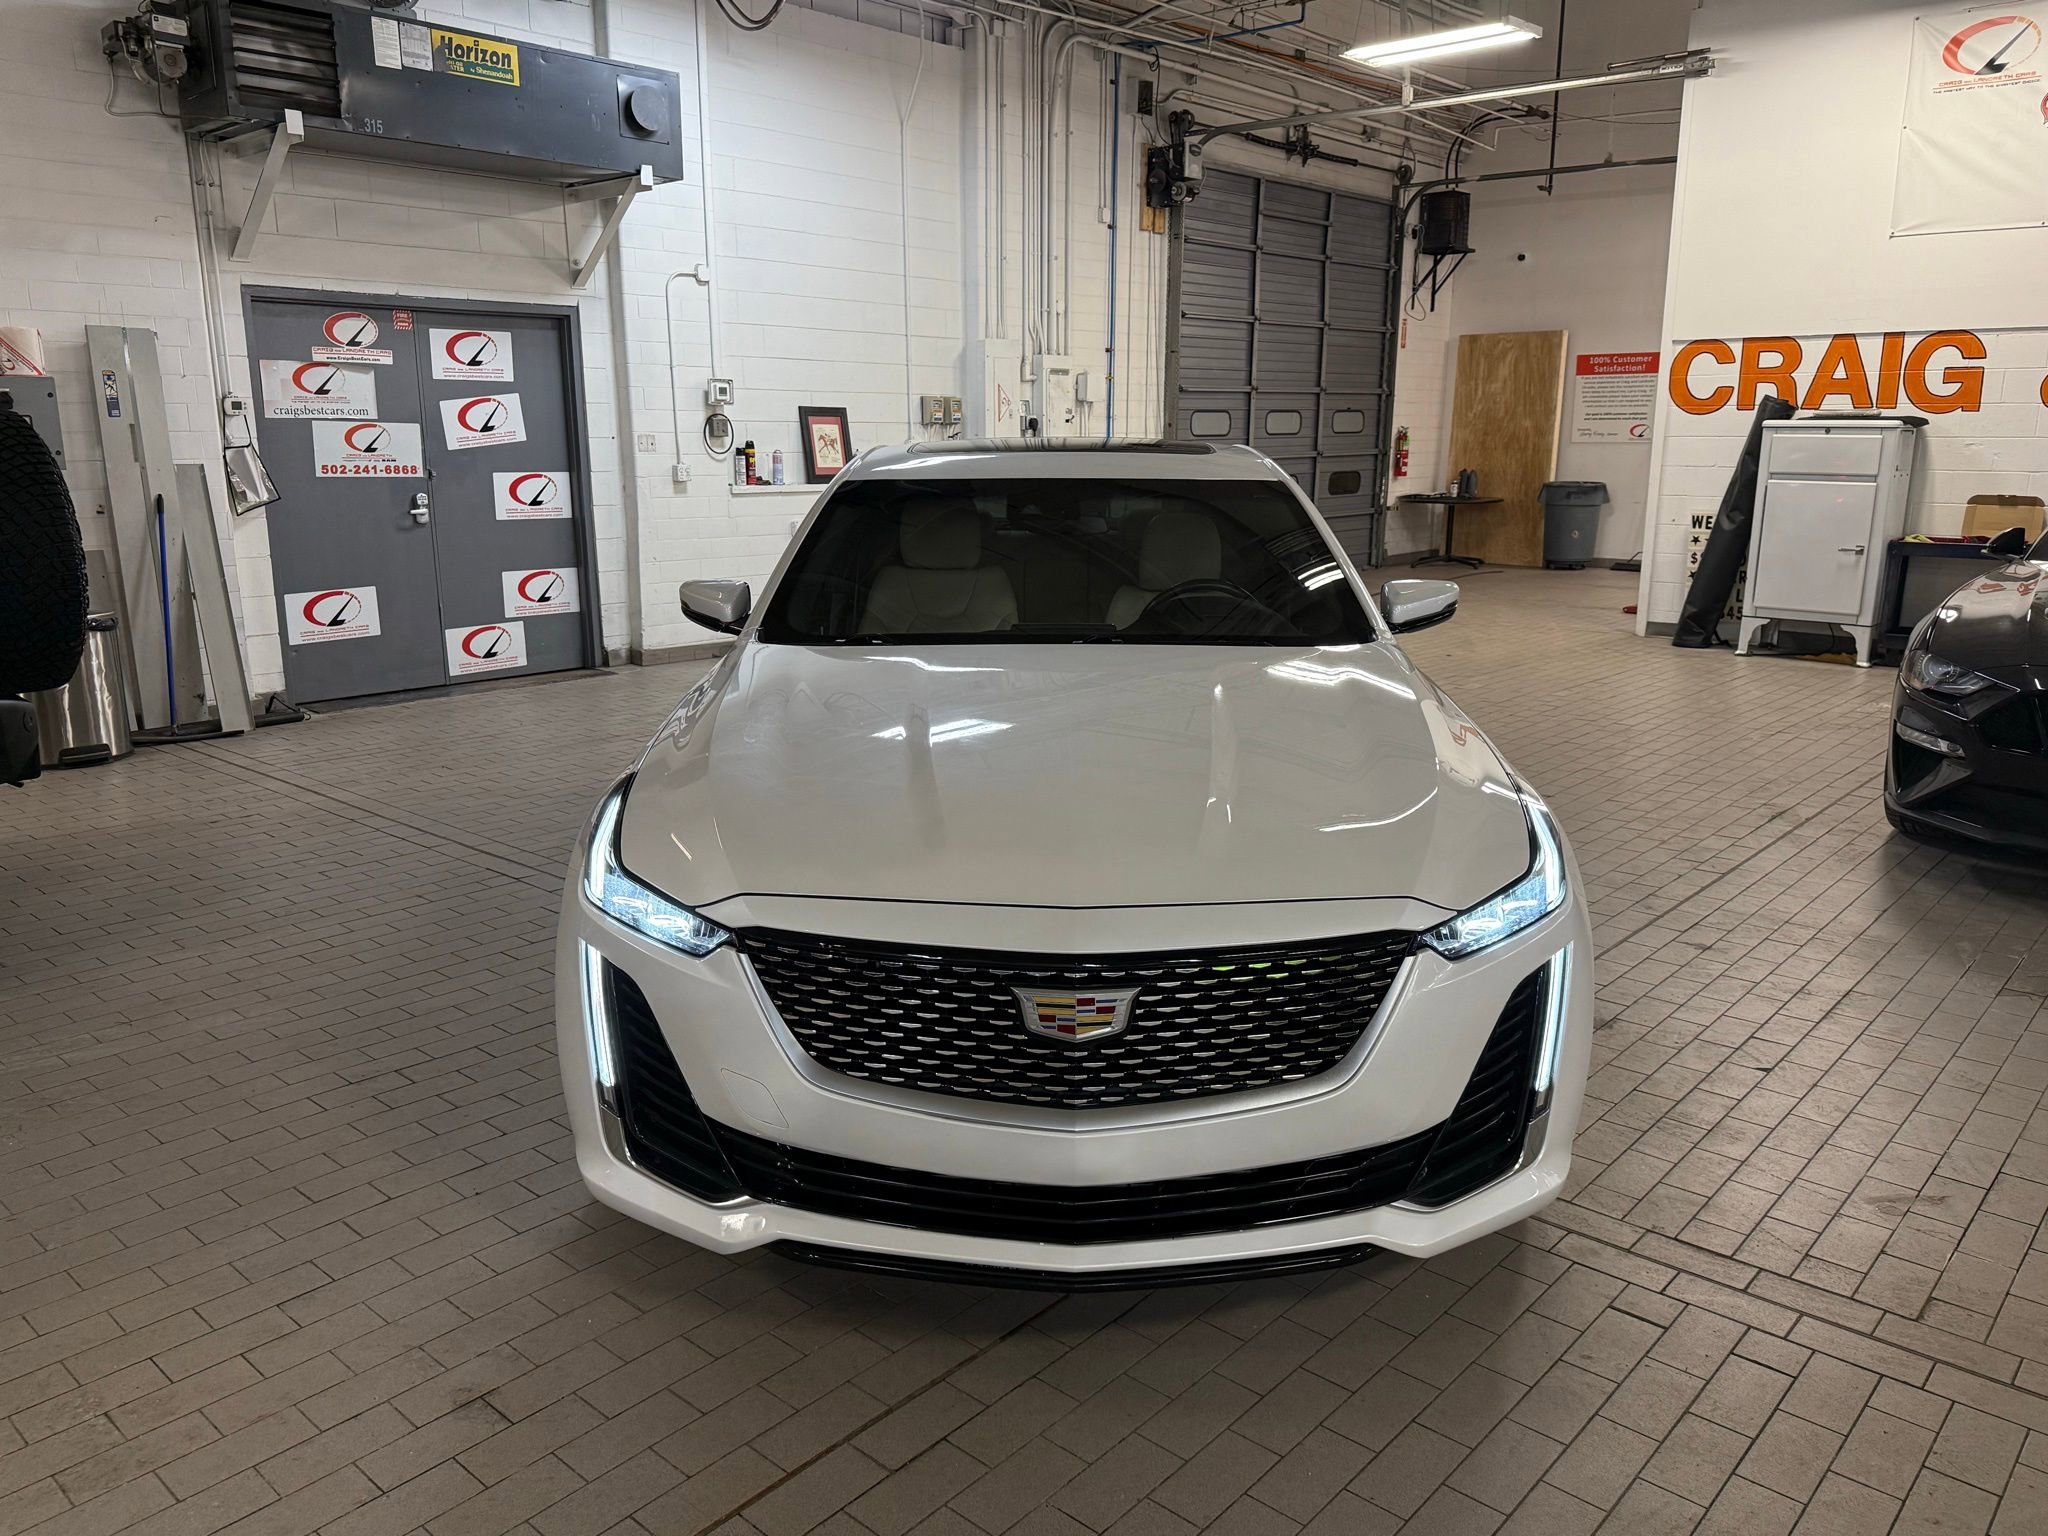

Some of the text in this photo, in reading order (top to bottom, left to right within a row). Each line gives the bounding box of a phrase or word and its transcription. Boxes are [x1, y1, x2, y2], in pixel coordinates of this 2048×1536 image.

[440, 36, 512, 68] Horizon
[476, 66, 513, 80] Shenandoah
[364, 118, 383, 134] 315
[1590, 356, 1610, 364] 100%
[1594, 364, 1646, 373] Satisfaction!
[1669, 330, 1987, 415] CRAIG
[273, 405, 369, 417] craigsbestcars.com
[321, 465, 418, 474] 502-241-6868
